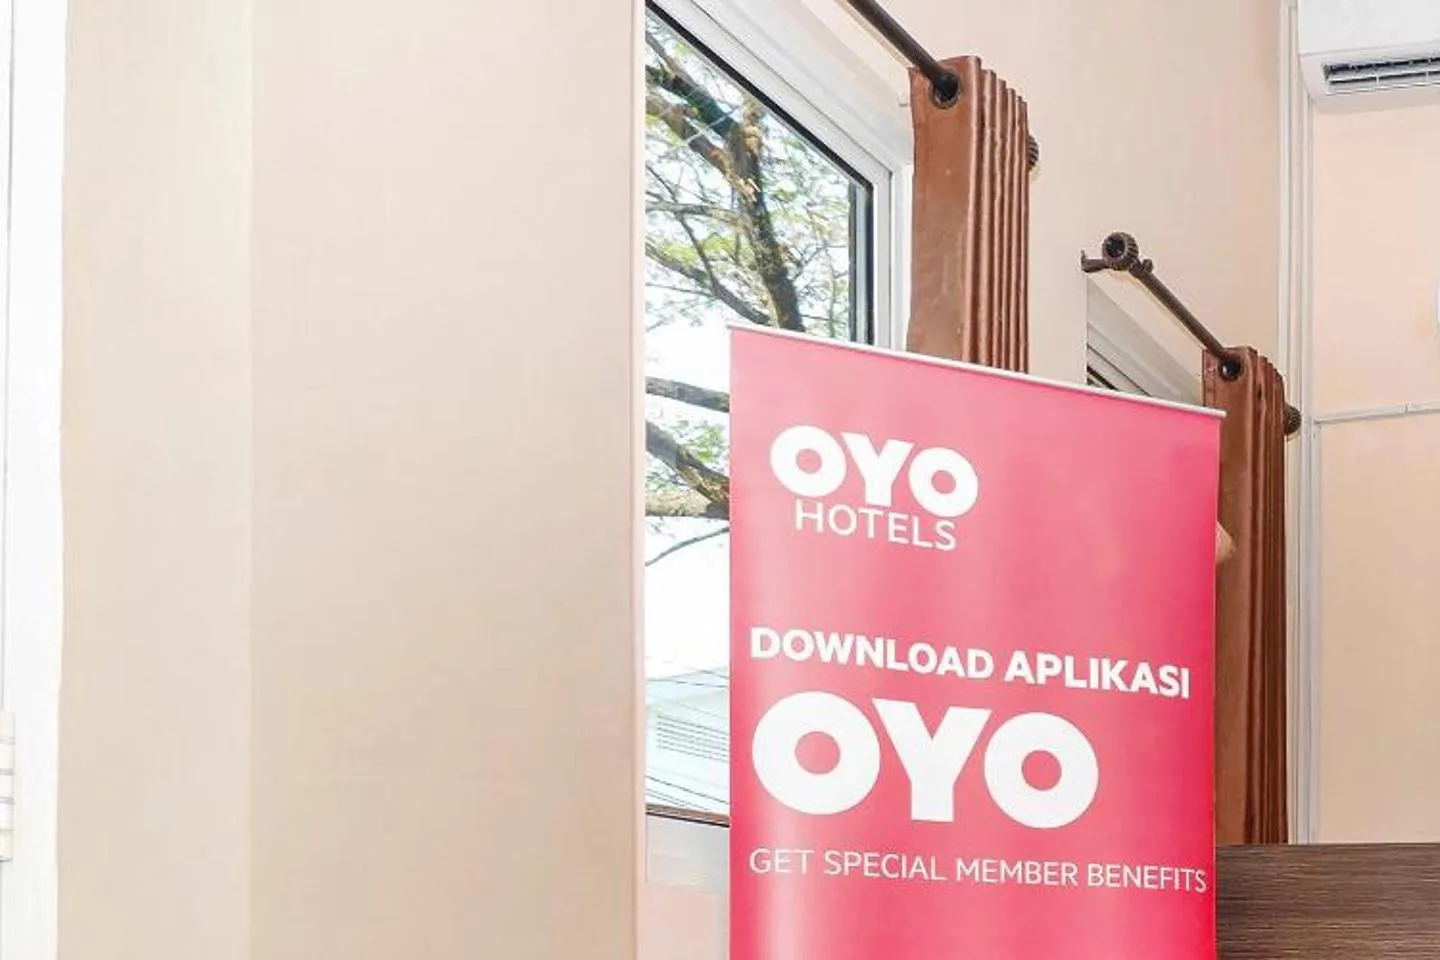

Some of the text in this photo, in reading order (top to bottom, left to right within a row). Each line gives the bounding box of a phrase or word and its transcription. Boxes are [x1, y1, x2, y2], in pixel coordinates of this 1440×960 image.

[770, 425, 979, 518] OYO
[795, 498, 957, 551] HOTELS
[750, 626, 1191, 699] DOWNLOAD APLIKASI
[752, 690, 1100, 829] OYO
[749, 848, 1207, 893] GET SPECIAL MEMBER BENEFITS
